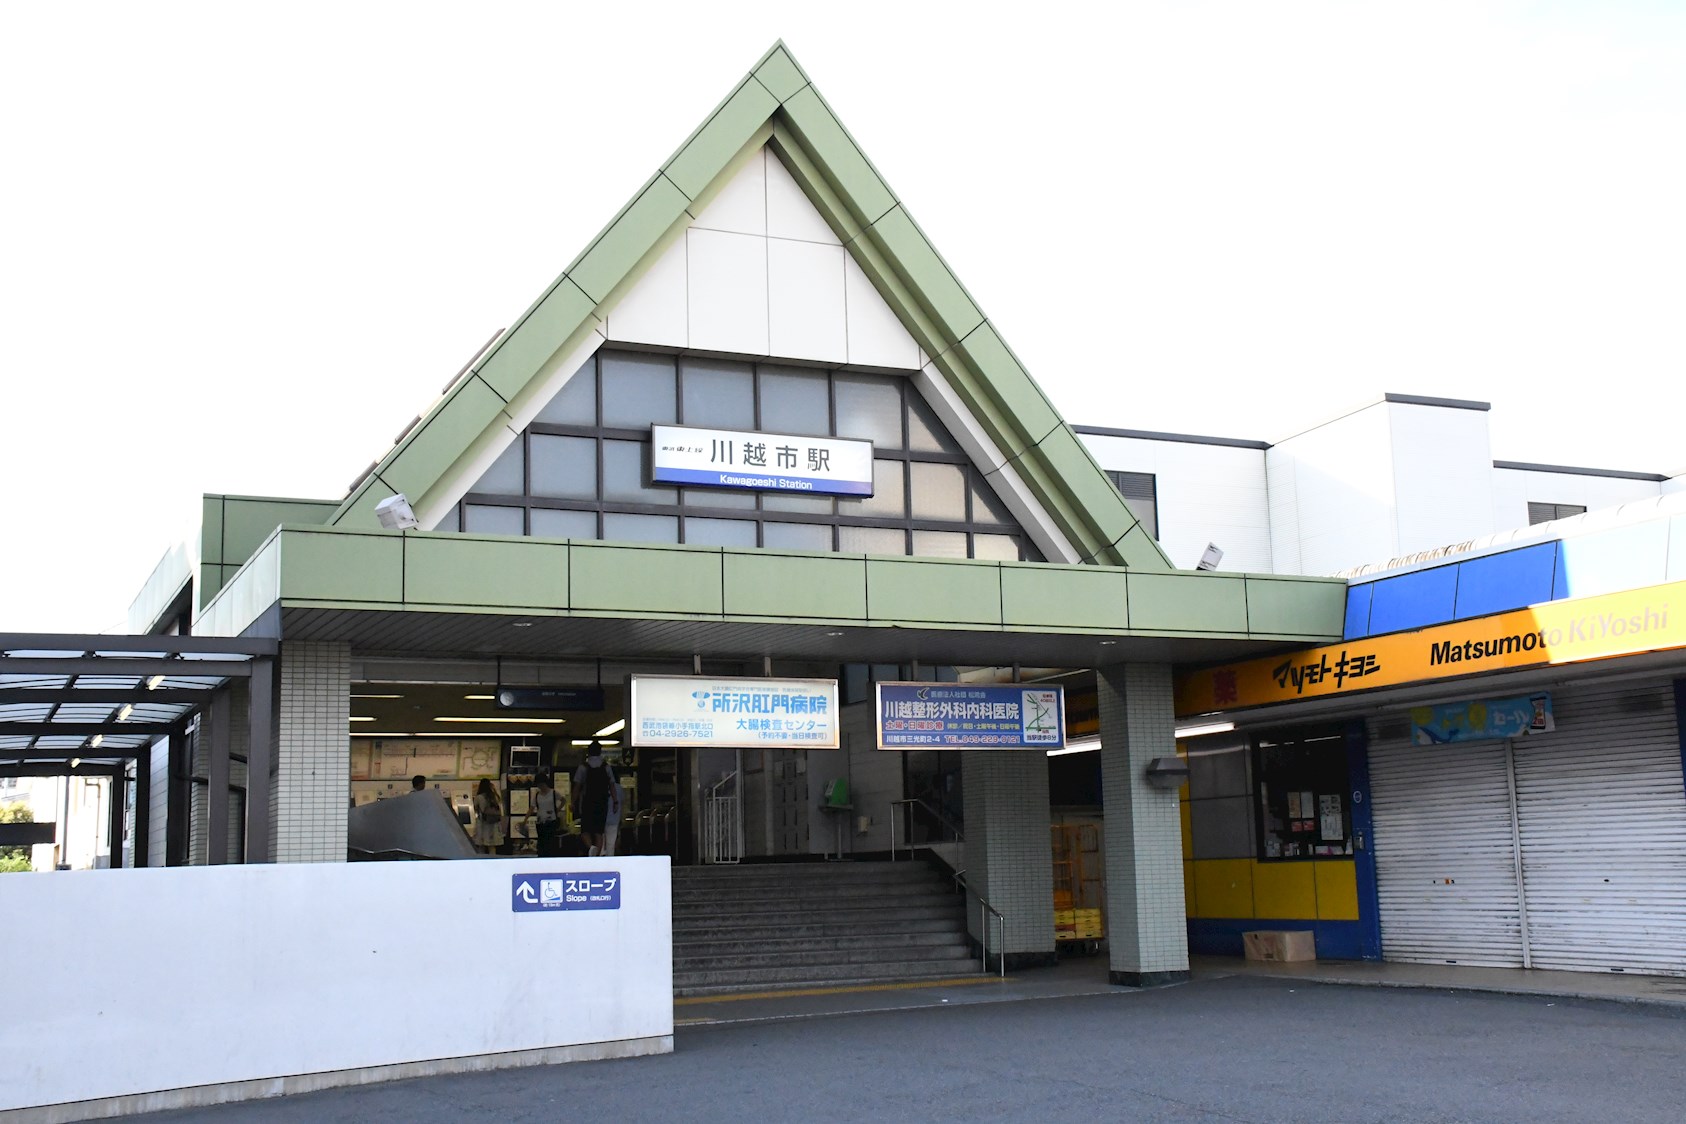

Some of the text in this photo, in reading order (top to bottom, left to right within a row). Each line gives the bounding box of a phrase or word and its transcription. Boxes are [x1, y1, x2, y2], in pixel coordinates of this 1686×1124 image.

[710, 439, 830, 472] 川越市駅
[720, 474, 813, 490] Kawagoeshi Station
[1430, 627, 1563, 666] Matsumoto
[1272, 650, 1381, 694] マツモトキヨシ
[712, 692, 827, 715] 所沢肛門病院
[885, 700, 1020, 720] 川越整形外科内科医院
[736, 718, 827, 731] 大腸検査センター
[565, 877, 617, 893] スロープ
[565, 894, 587, 903] Slope
